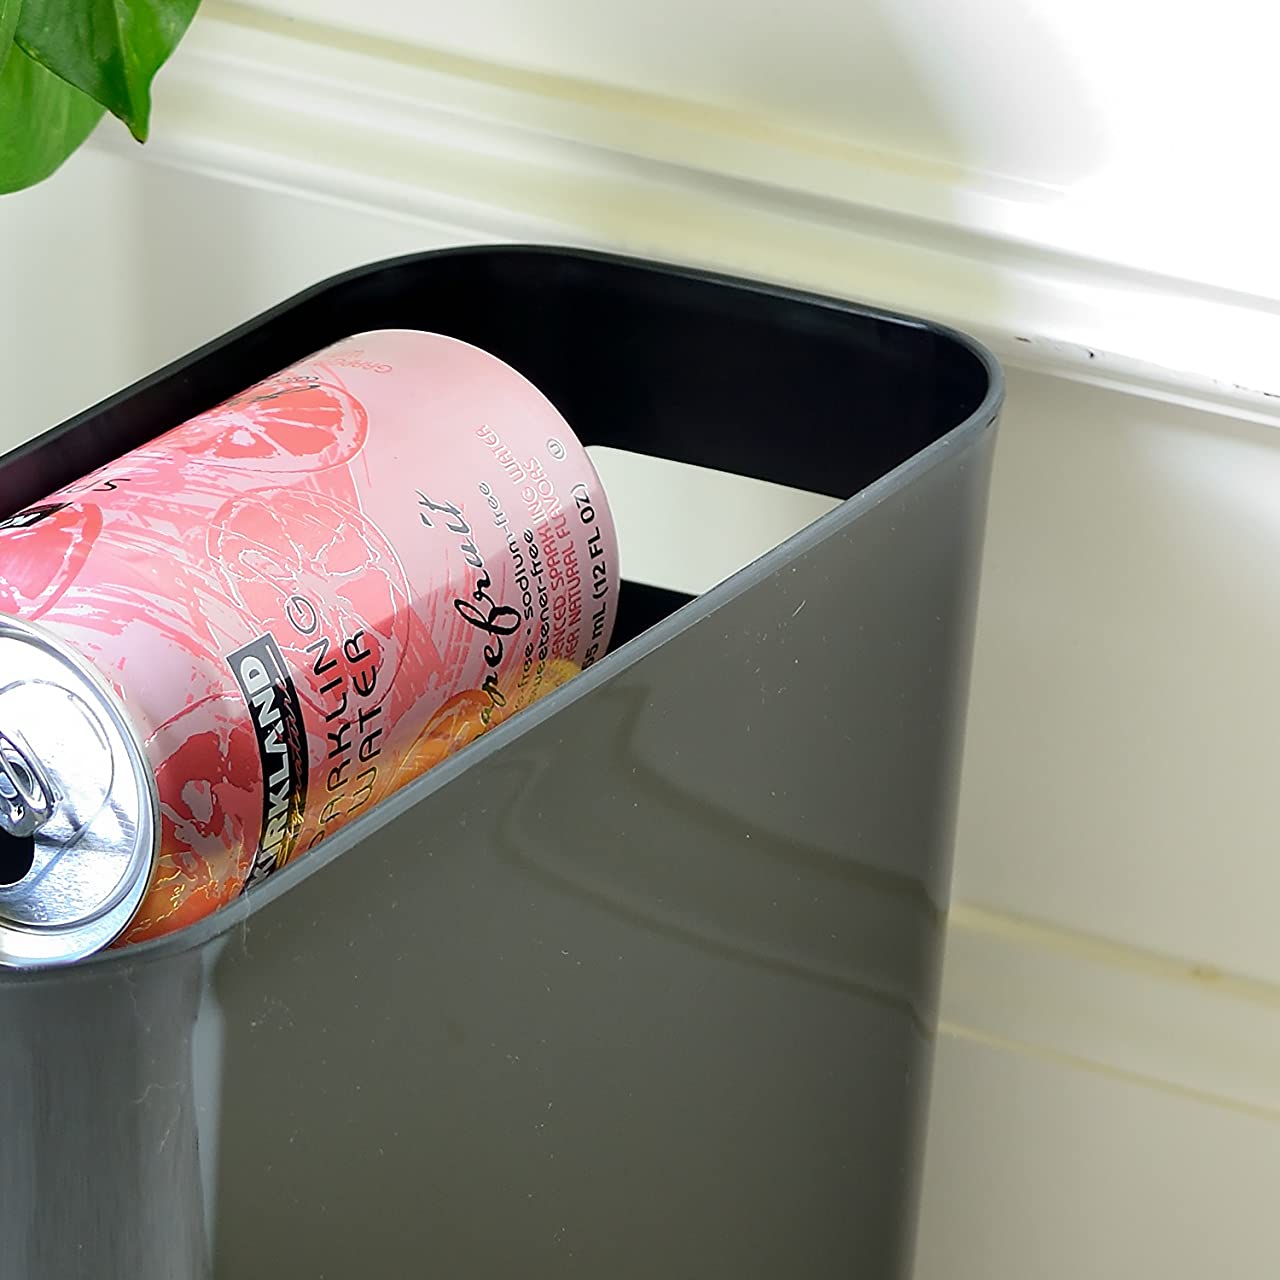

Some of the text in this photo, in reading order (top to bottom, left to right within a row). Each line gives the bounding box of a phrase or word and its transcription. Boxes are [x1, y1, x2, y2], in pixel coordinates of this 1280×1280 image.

[475, 424, 526, 484] WATER
[522, 486, 565, 591] SPARKLING
[523, 457, 570, 539] FLAVORS
[570, 483, 595, 524] OZ)
[478, 481, 535, 621] sodium-free
[561, 541, 582, 627] NATURAL
[587, 526, 603, 559] FL
[592, 561, 609, 599] (12
[414, 489, 520, 740] apefruit
[592, 601, 606, 640] mL
[344, 628, 382, 813] WATER
[240, 656, 288, 890] KIRKLAND
